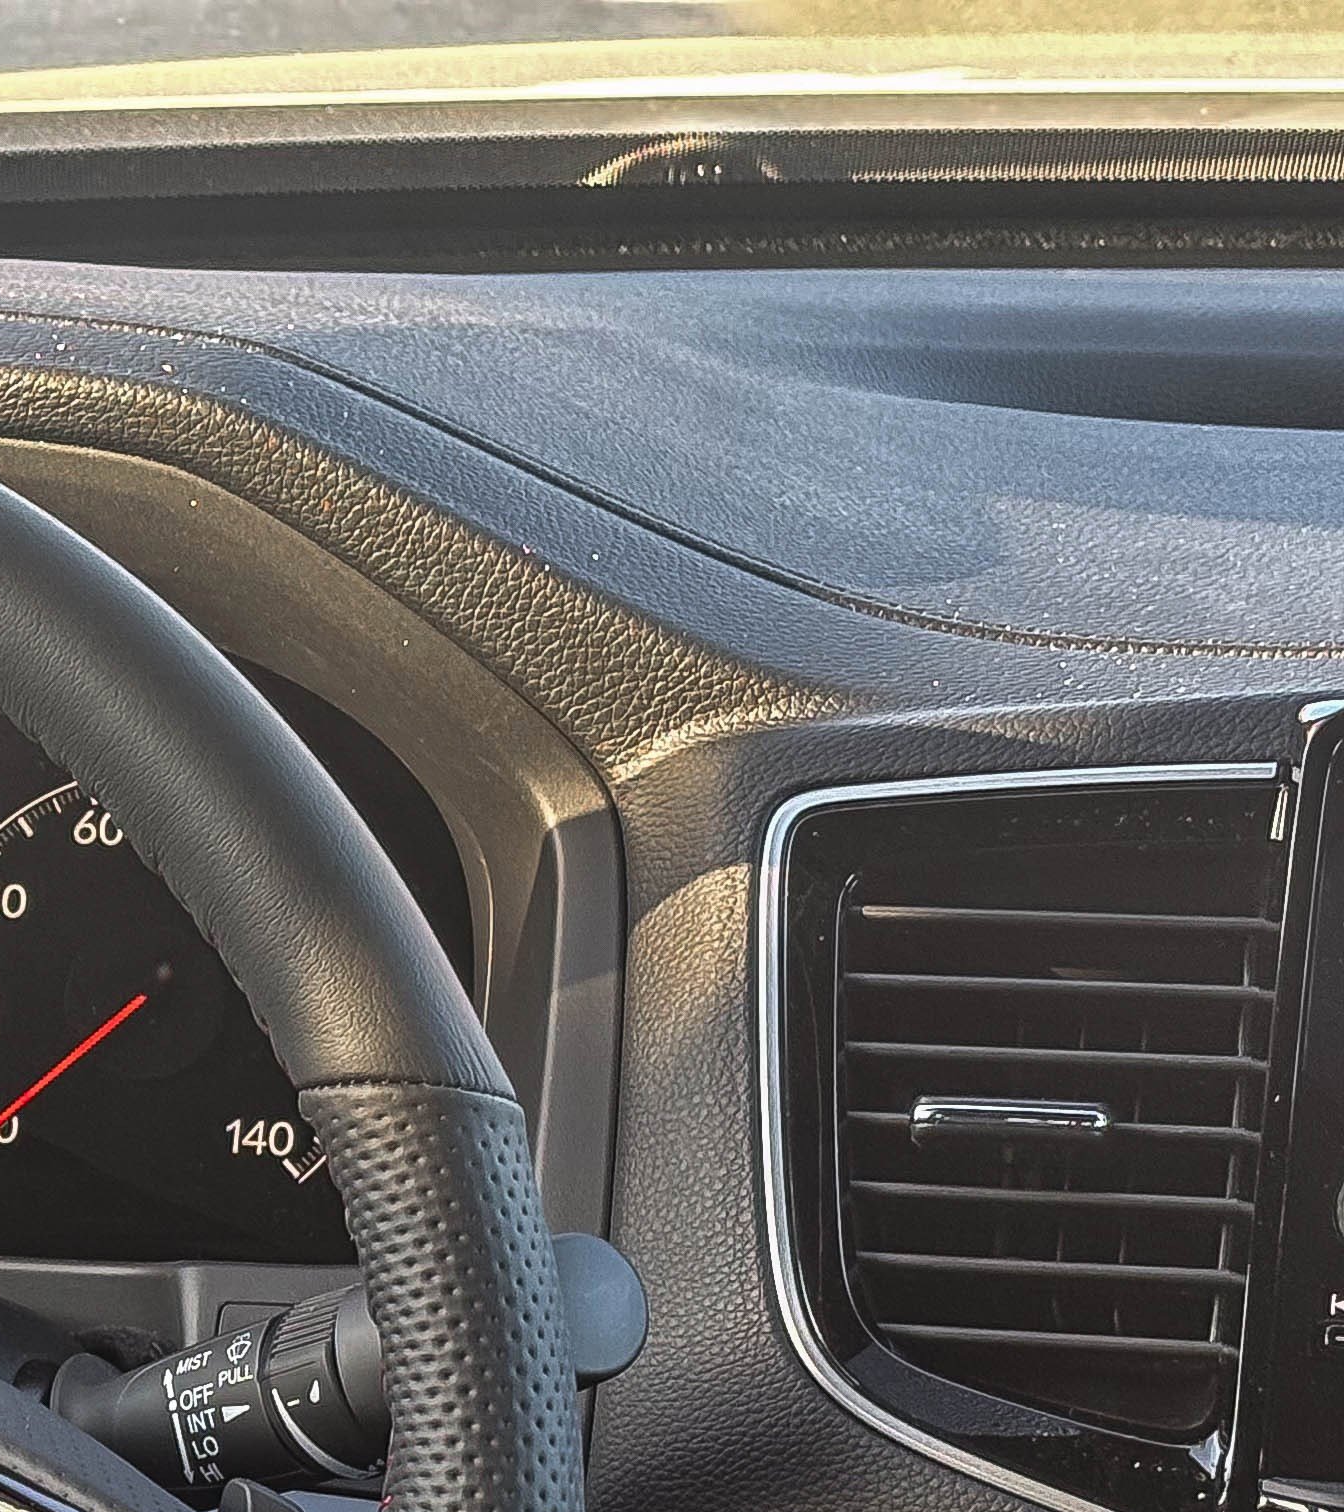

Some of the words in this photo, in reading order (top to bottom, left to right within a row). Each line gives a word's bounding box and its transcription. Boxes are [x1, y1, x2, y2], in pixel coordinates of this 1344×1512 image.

[72, 809, 124, 846] 60
[225, 1118, 295, 1156] 140
[175, 1350, 213, 1376] MIST
[218, 1364, 254, 1388] PULL
[179, 1382, 214, 1411] OFF
[186, 1408, 216, 1435] INT
[191, 1436, 219, 1460] LO
[199, 1463, 224, 1483] HI
